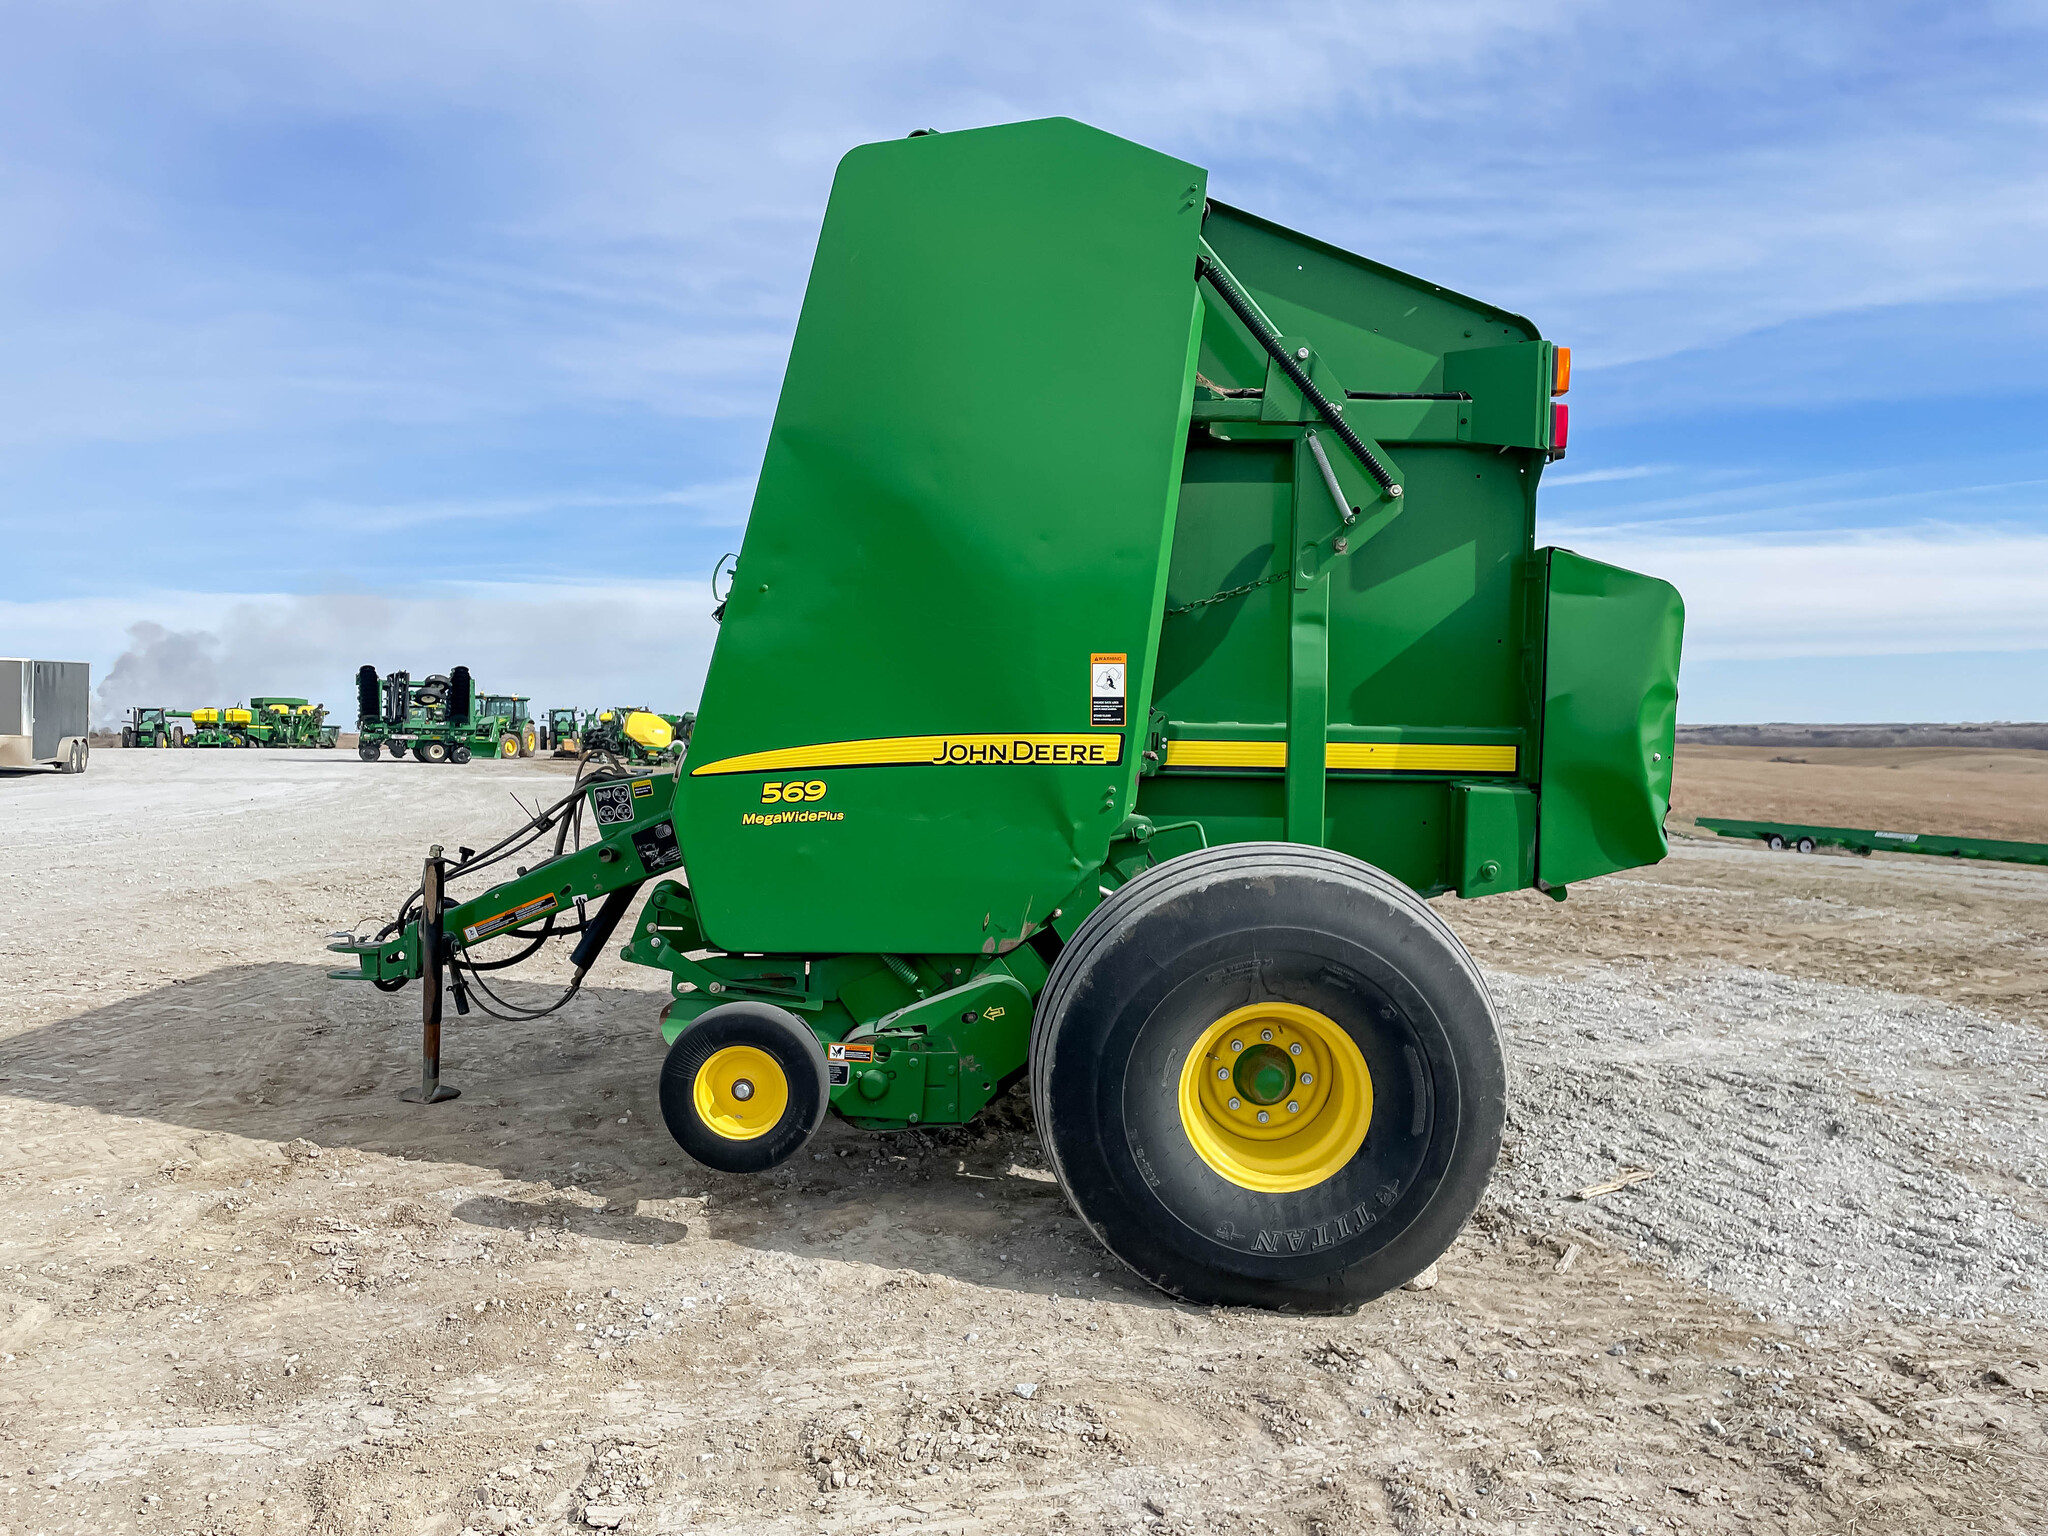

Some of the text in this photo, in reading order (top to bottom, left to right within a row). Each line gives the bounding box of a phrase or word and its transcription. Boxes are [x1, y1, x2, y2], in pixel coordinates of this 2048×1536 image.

[933, 740, 1105, 762] JOHN DEERE
[761, 780, 828, 804] 569
[741, 810, 845, 826] MegaWidePlus
[1250, 1201, 1377, 1253] TITAN
